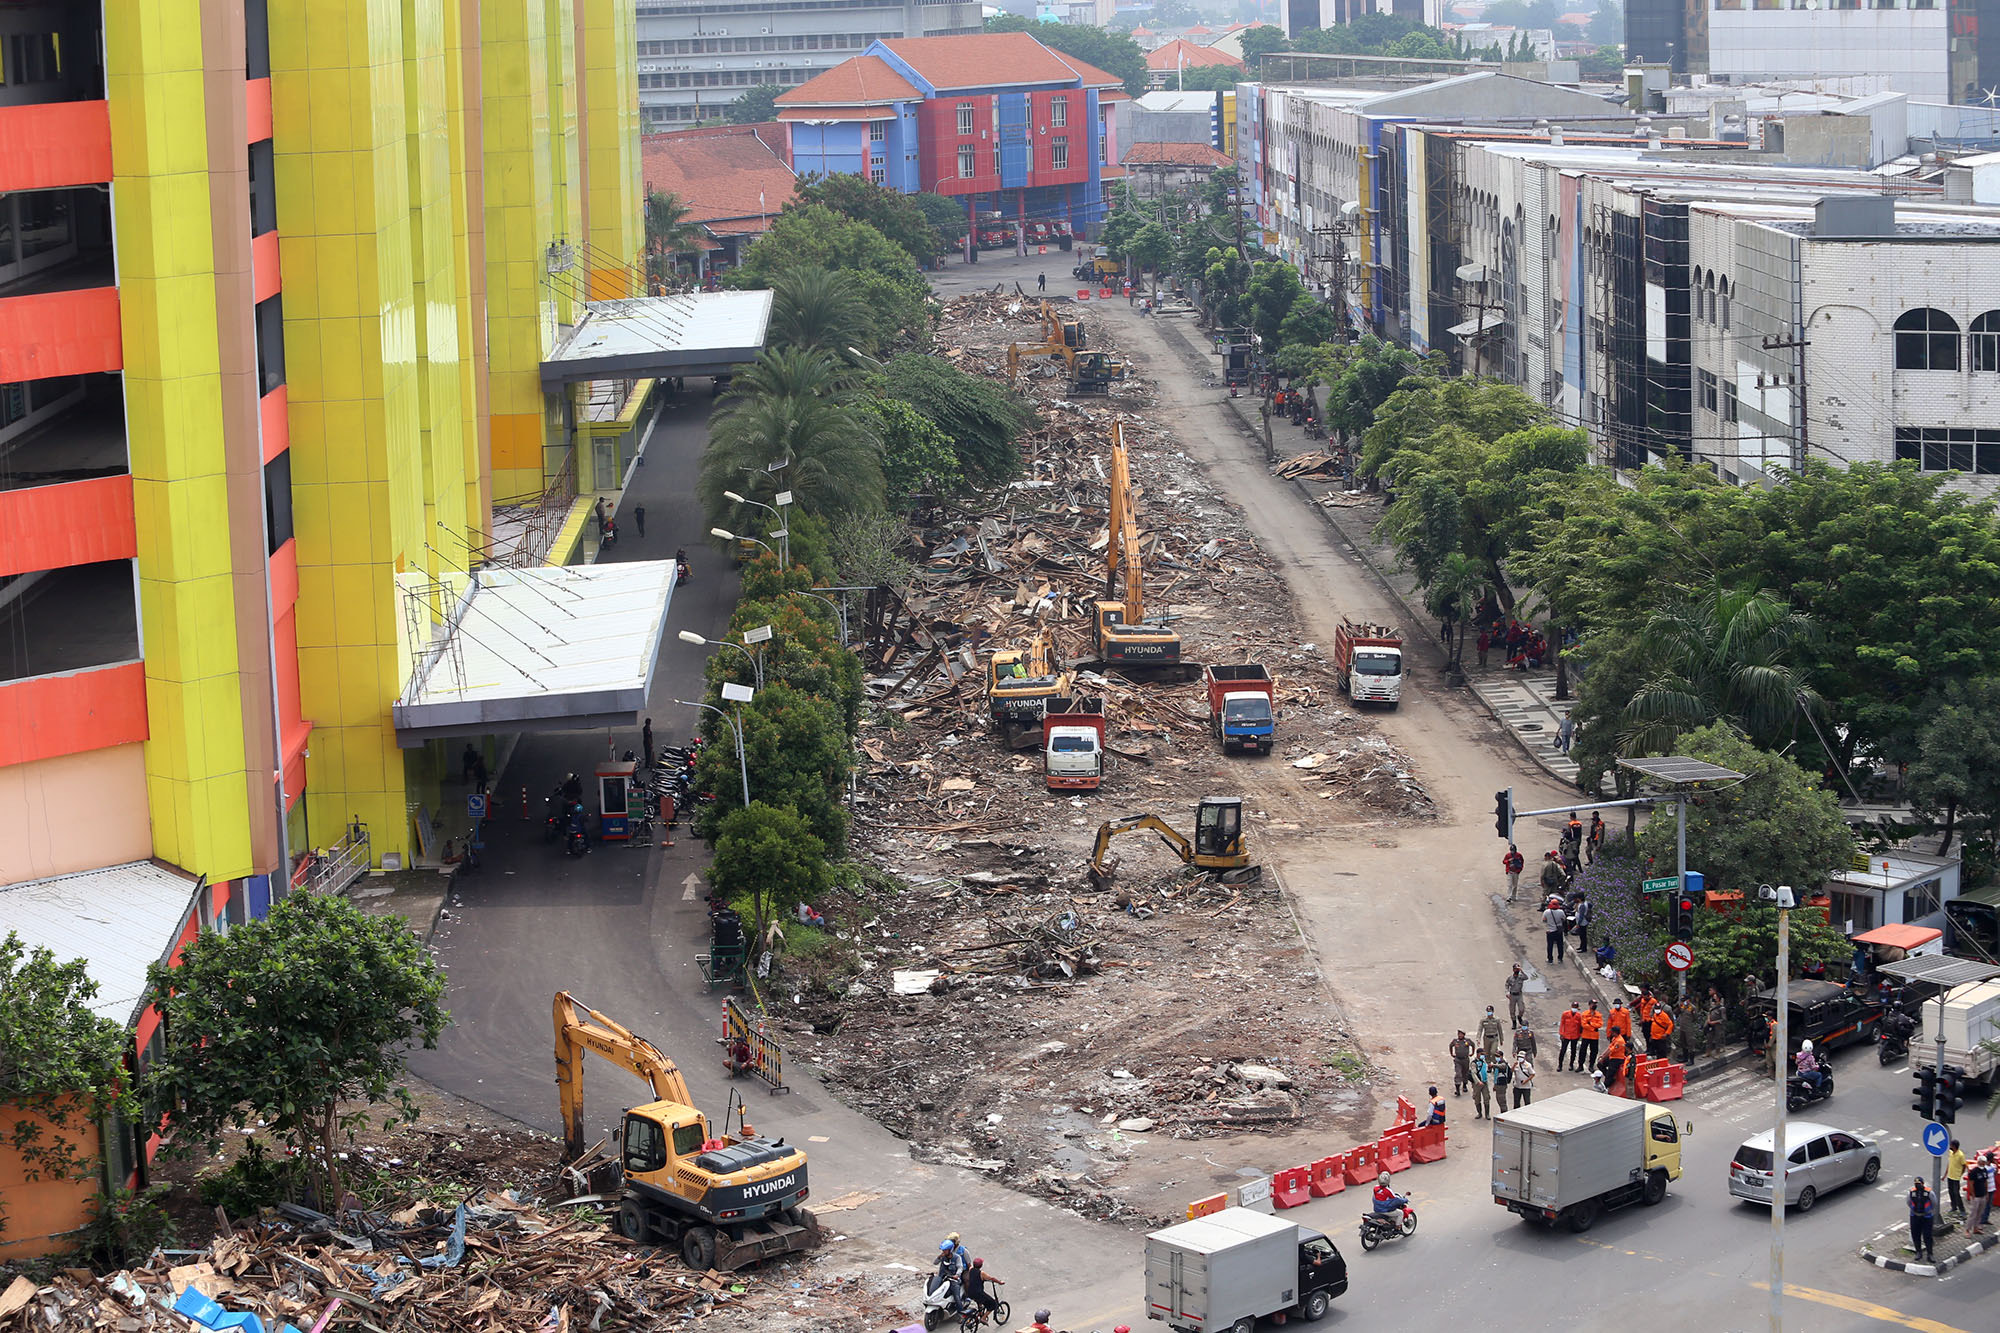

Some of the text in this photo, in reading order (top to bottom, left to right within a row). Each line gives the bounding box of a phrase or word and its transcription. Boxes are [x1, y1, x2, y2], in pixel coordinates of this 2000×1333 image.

[1124, 646, 1166, 654] HYUNDA
[1652, 881, 1667, 889] Pasar
[586, 1037, 615, 1056] HYUNDAI
[743, 1174, 795, 1199] HYUNDAI
